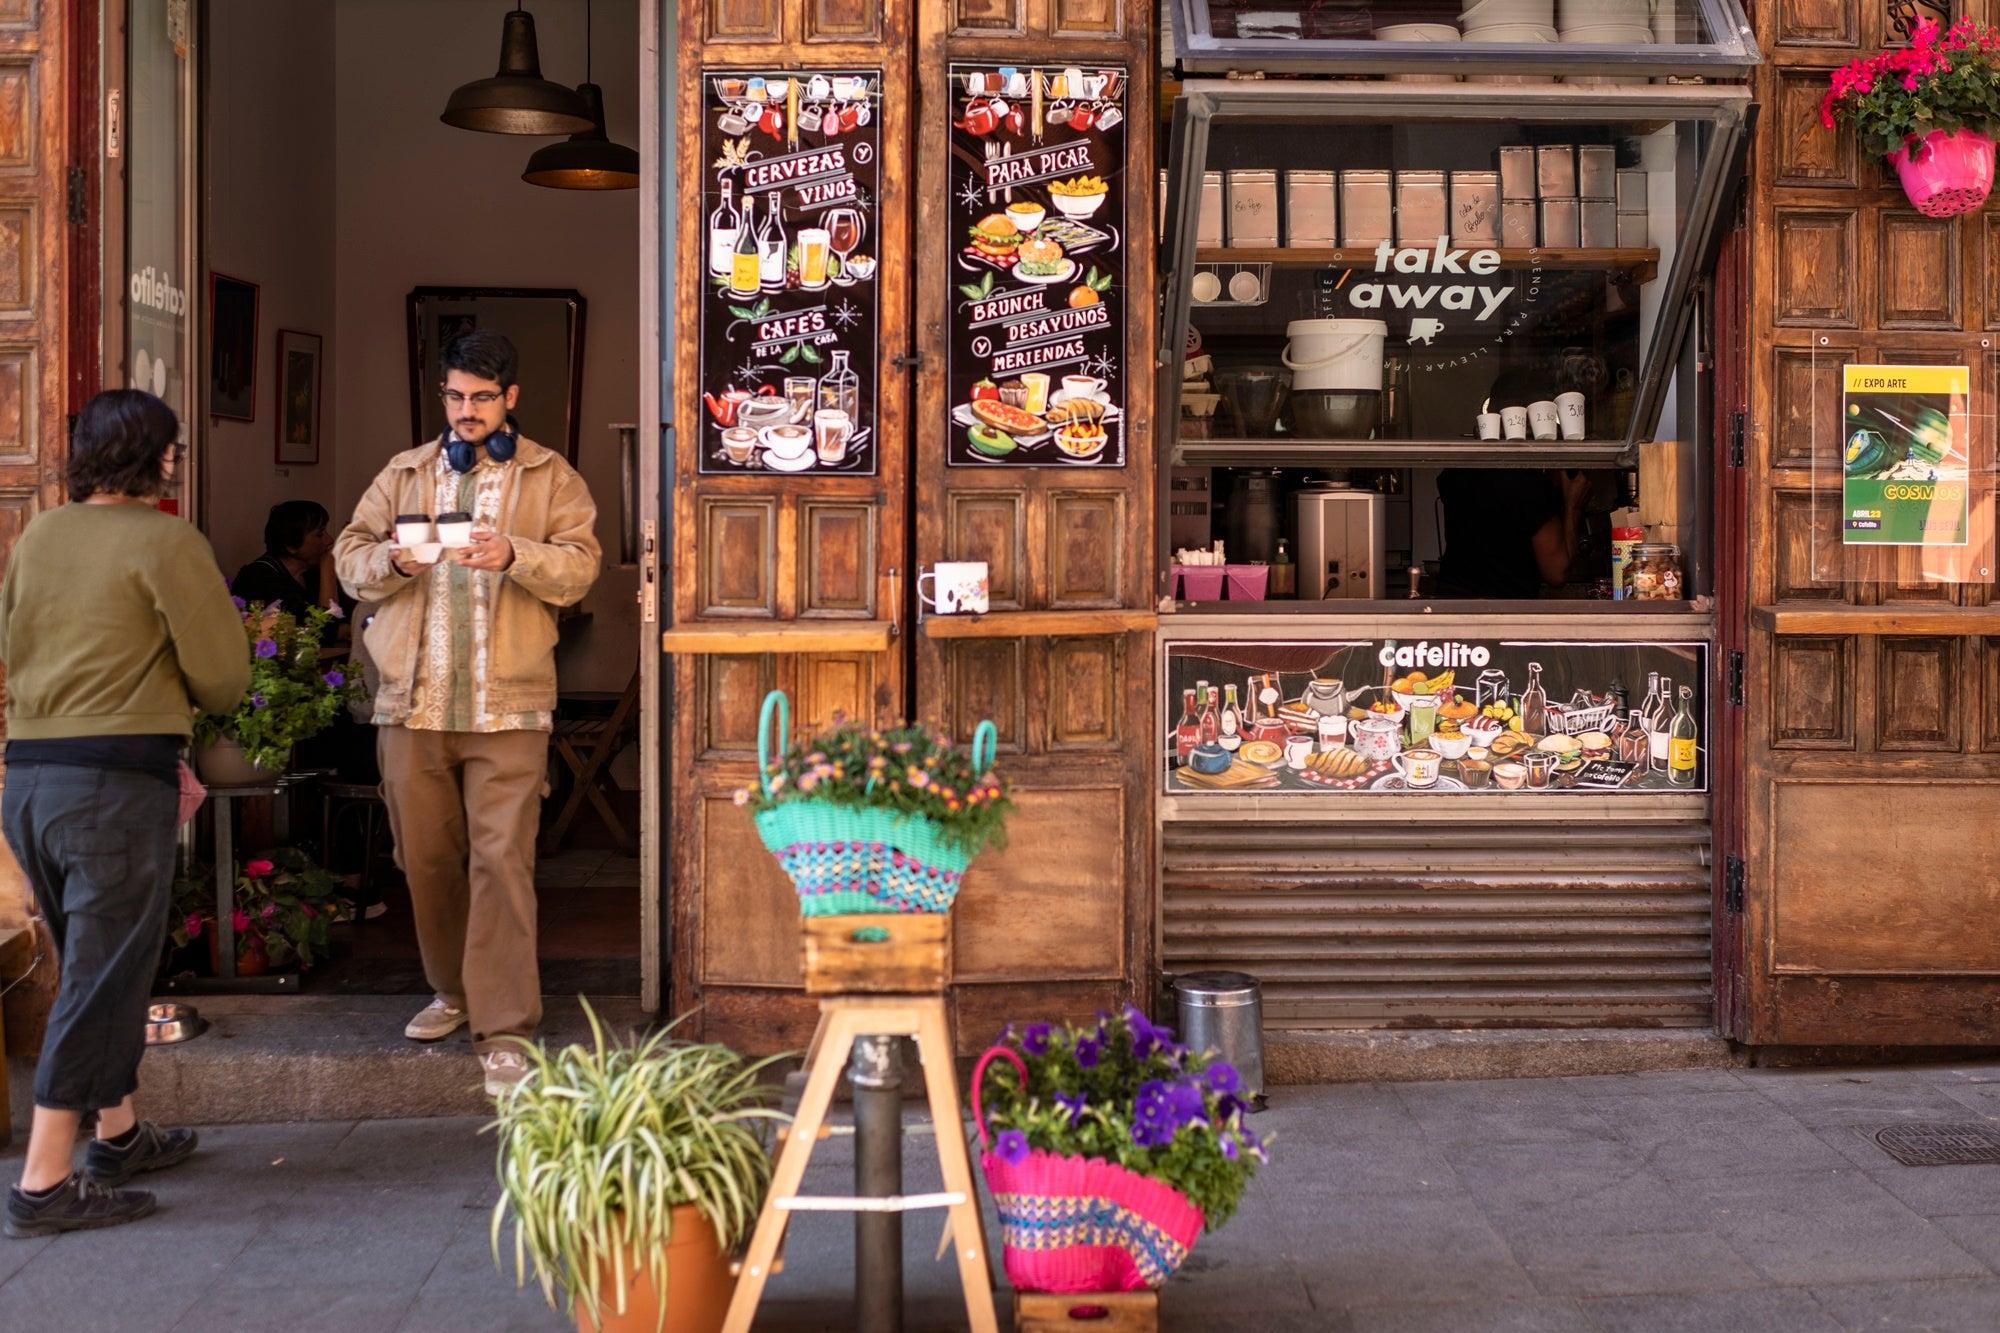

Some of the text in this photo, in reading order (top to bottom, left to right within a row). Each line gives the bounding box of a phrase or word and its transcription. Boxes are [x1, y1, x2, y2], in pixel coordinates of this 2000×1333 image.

[747, 151, 845, 187] CERVEZAS
[988, 146, 1090, 186] PARA PICAR
[799, 179, 856, 205] VINOS
[1328, 253, 1342, 269] TO
[1374, 235, 1501, 274] take
[1526, 247, 1542, 302] BUENO)
[973, 293, 1044, 321] BRUNCH
[1349, 282, 1515, 321] away
[1008, 306, 1108, 341] DESAYUNOS
[1494, 312, 1528, 343] PARA
[756, 333, 839, 358] DE LA CASA
[992, 341, 1085, 371] MERIENDAS
[1425, 347, 1488, 372] LLEVAR
[1864, 379, 1885, 388] EXPO
[1887, 380, 1907, 389] ARTE
[1884, 484, 1960, 500] COSMOS
[1378, 641, 1491, 668] cafelito
[1593, 773, 1621, 782] cafelito
